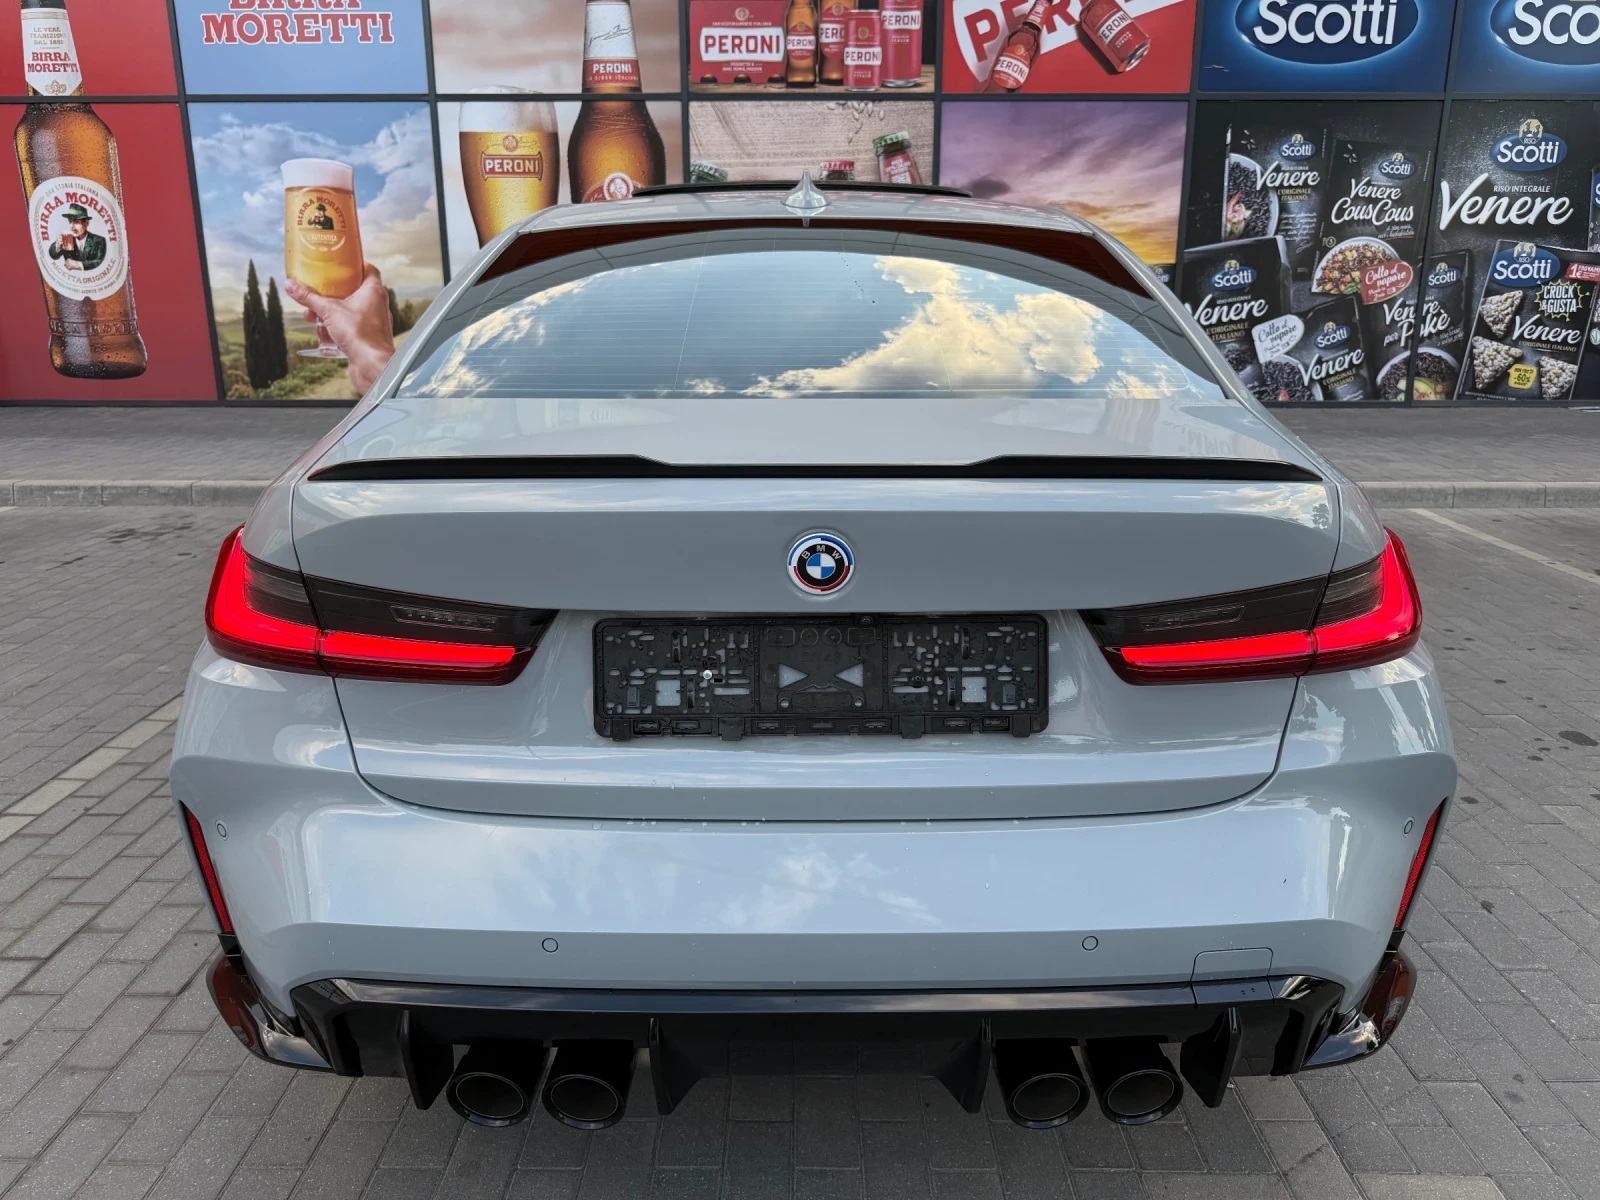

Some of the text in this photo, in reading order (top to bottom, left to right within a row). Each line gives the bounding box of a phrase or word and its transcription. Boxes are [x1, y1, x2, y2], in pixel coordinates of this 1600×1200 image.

[201, 13, 394, 44] MORETTI
[882, 15, 920, 26] PERONI
[1254, 0, 1395, 45] Scotti
[787, 38, 815, 47] PERONI
[820, 27, 845, 39] PERO
[704, 35, 780, 54] PERONI
[32, 52, 71, 61] BIRRA
[27, 63, 78, 73] MORETTI
[593, 63, 632, 74] PERONI
[1281, 145, 1312, 156] Scotti
[1497, 141, 1559, 163] Scotti
[485, 159, 539, 173] PERONI
[1381, 162, 1411, 175] Scotti
[1256, 161, 1320, 191] Venere
[1350, 177, 1402, 199] Venere
[1512, 185, 1551, 193] INTEGRALE
[1439, 173, 1574, 230] Venere
[40, 192, 117, 242] BIRRA MORETTI
[297, 196, 346, 228] BIRRA MORETTI
[52, 258, 116, 284] RICETTA ORIGINALE
[1213, 270, 1252, 288] Scotti
[1365, 265, 1389, 284] Cotto
[1428, 270, 1456, 286] Scotti
[1493, 260, 1551, 279] Scotti
[1544, 285, 1575, 298] CROCK
[1184, 293, 1269, 326] Venere
[1383, 298, 1441, 325] Venre
[1541, 299, 1576, 312] &GUSTA
[1205, 322, 1249, 335] L'ORIGINALE
[1211, 331, 1245, 341] ITALIANO
[1317, 327, 1347, 347] Scotti
[1398, 309, 1451, 347] Pkè
[1512, 314, 1582, 344] Venere
[1298, 349, 1364, 387] Venere
[801, 544, 841, 560] BMW
